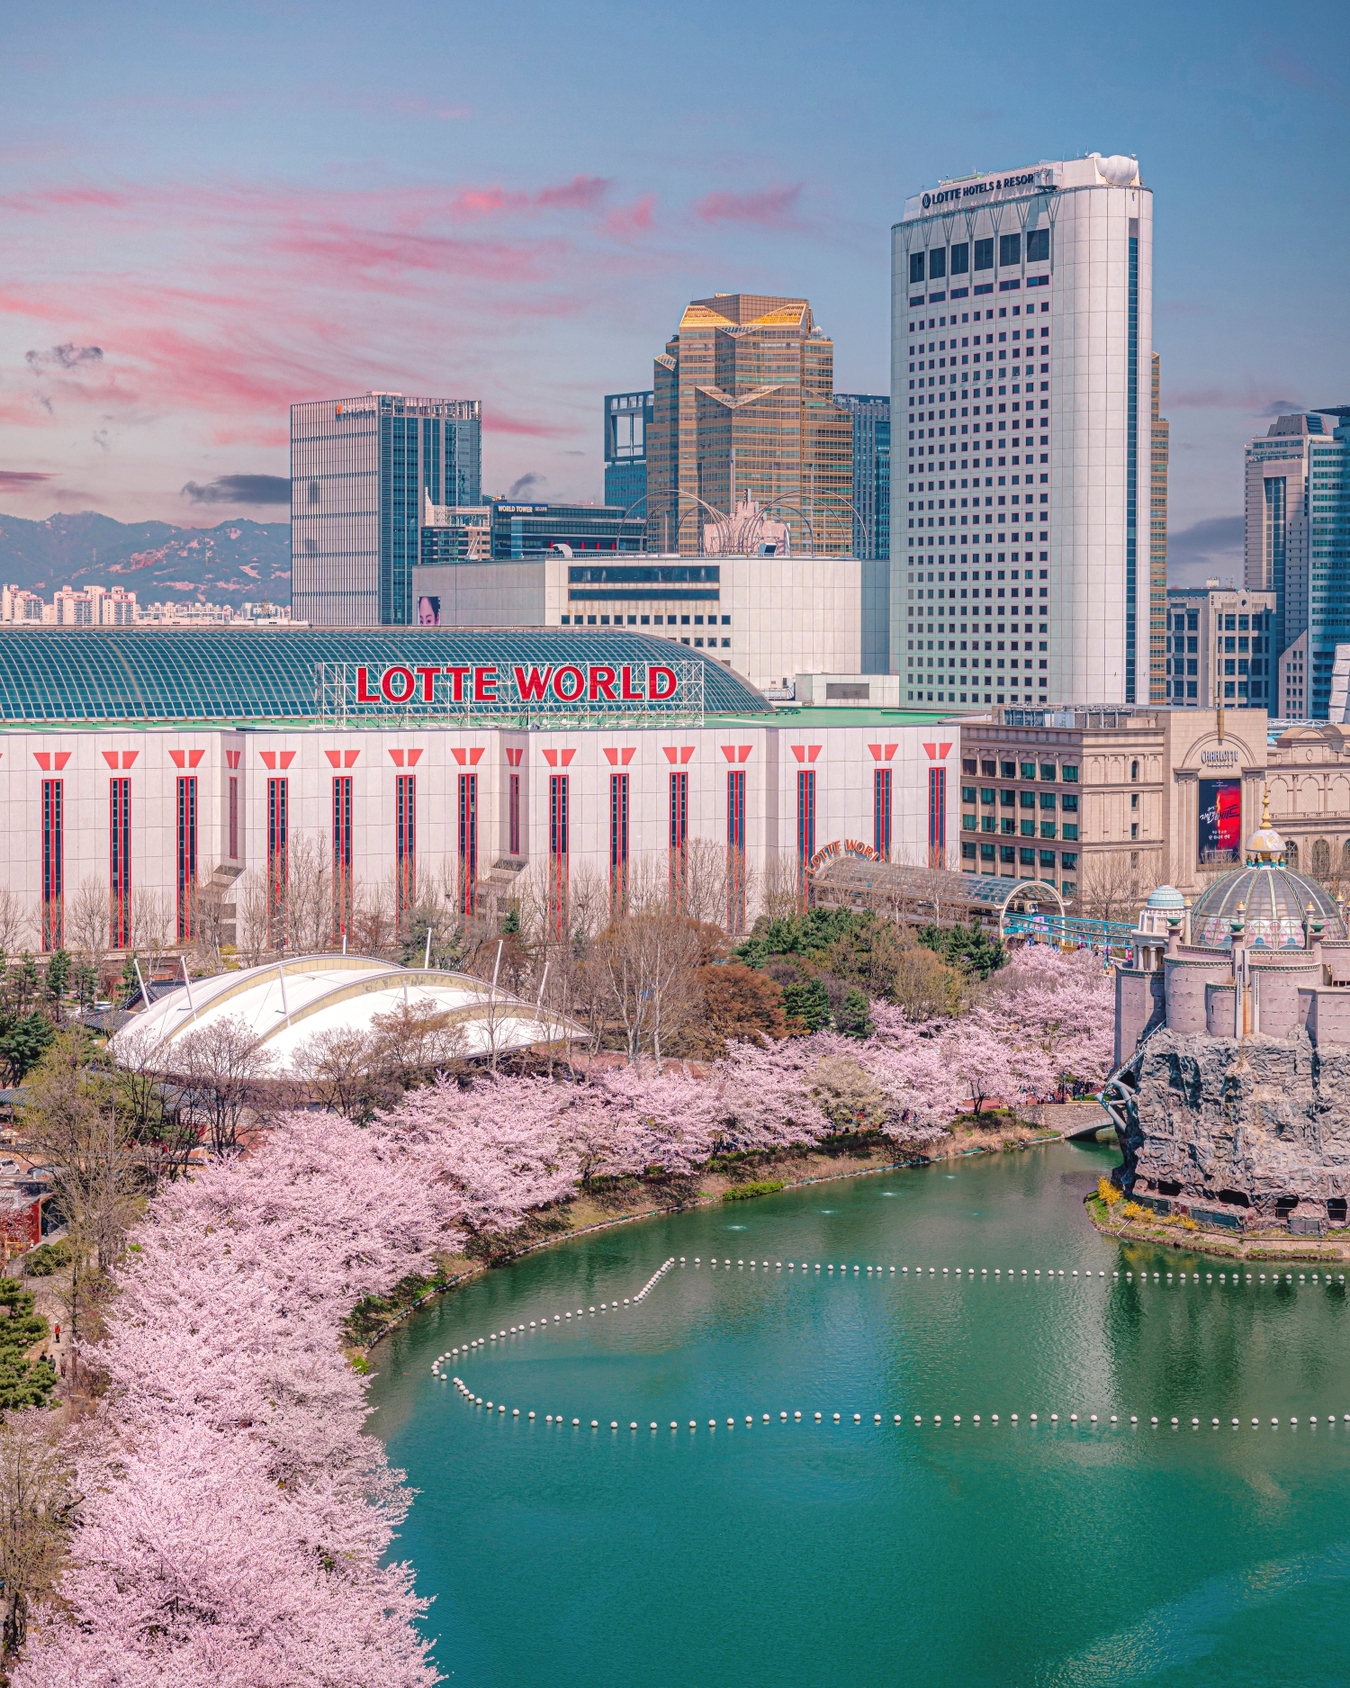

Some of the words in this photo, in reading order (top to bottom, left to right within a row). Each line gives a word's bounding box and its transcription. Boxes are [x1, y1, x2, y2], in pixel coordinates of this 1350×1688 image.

[932, 188, 962, 205] LOTTE
[963, 181, 994, 197] HOTELS
[996, 180, 1002, 190] &
[355, 665, 498, 703] LOTTE
[513, 665, 678, 702] WORLD
[805, 840, 842, 874] LOTTE
[844, 839, 885, 862] WORL
